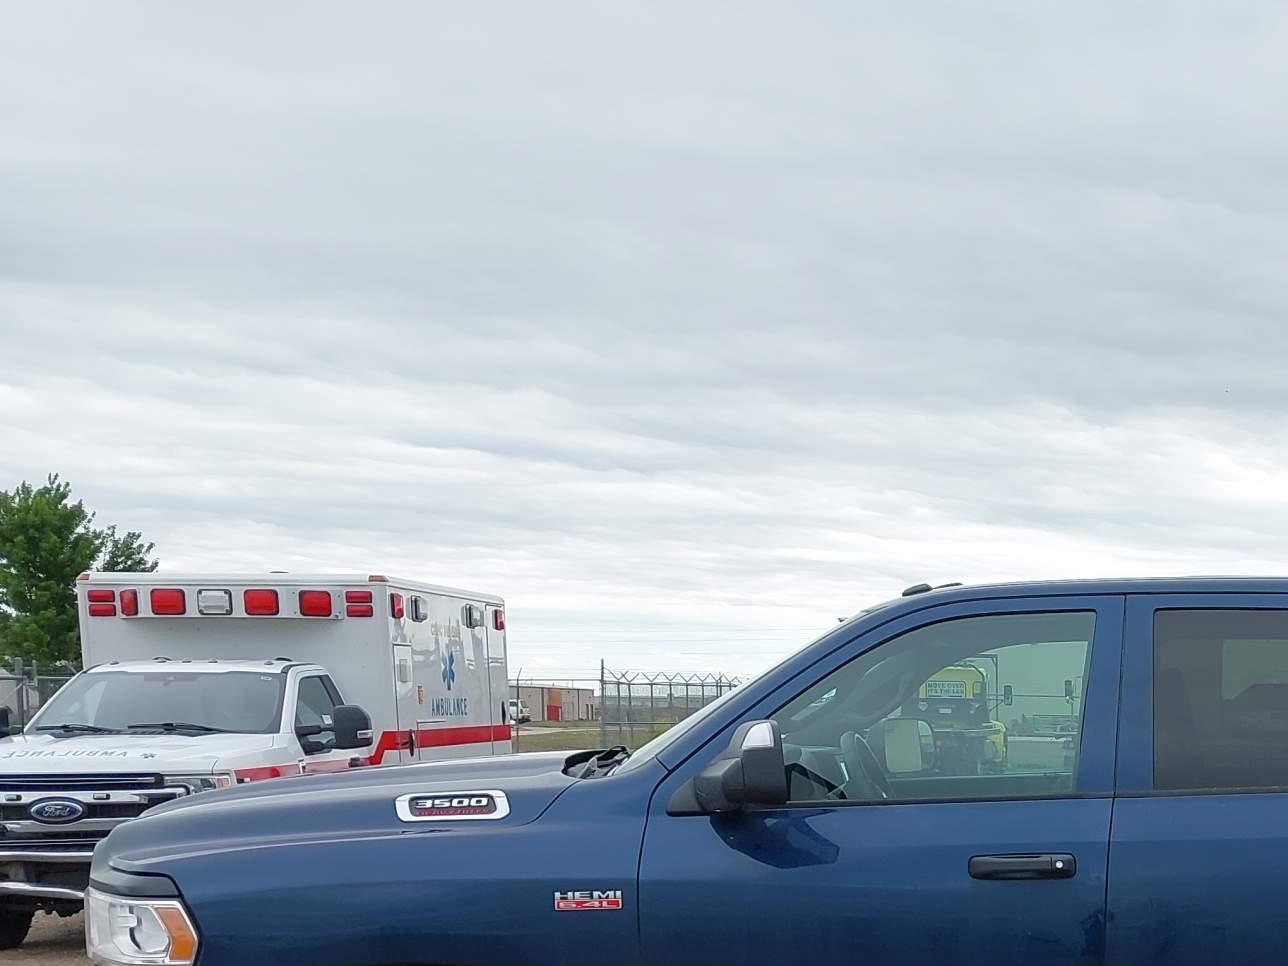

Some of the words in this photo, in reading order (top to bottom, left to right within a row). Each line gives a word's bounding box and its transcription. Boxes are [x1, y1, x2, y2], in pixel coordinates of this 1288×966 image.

[431, 698, 468, 716] AMBULANCE
[415, 797, 489, 808] 3500
[43, 805, 71, 817] Ford
[554, 890, 622, 900] HEMI
[559, 901, 617, 909] 6.4L
